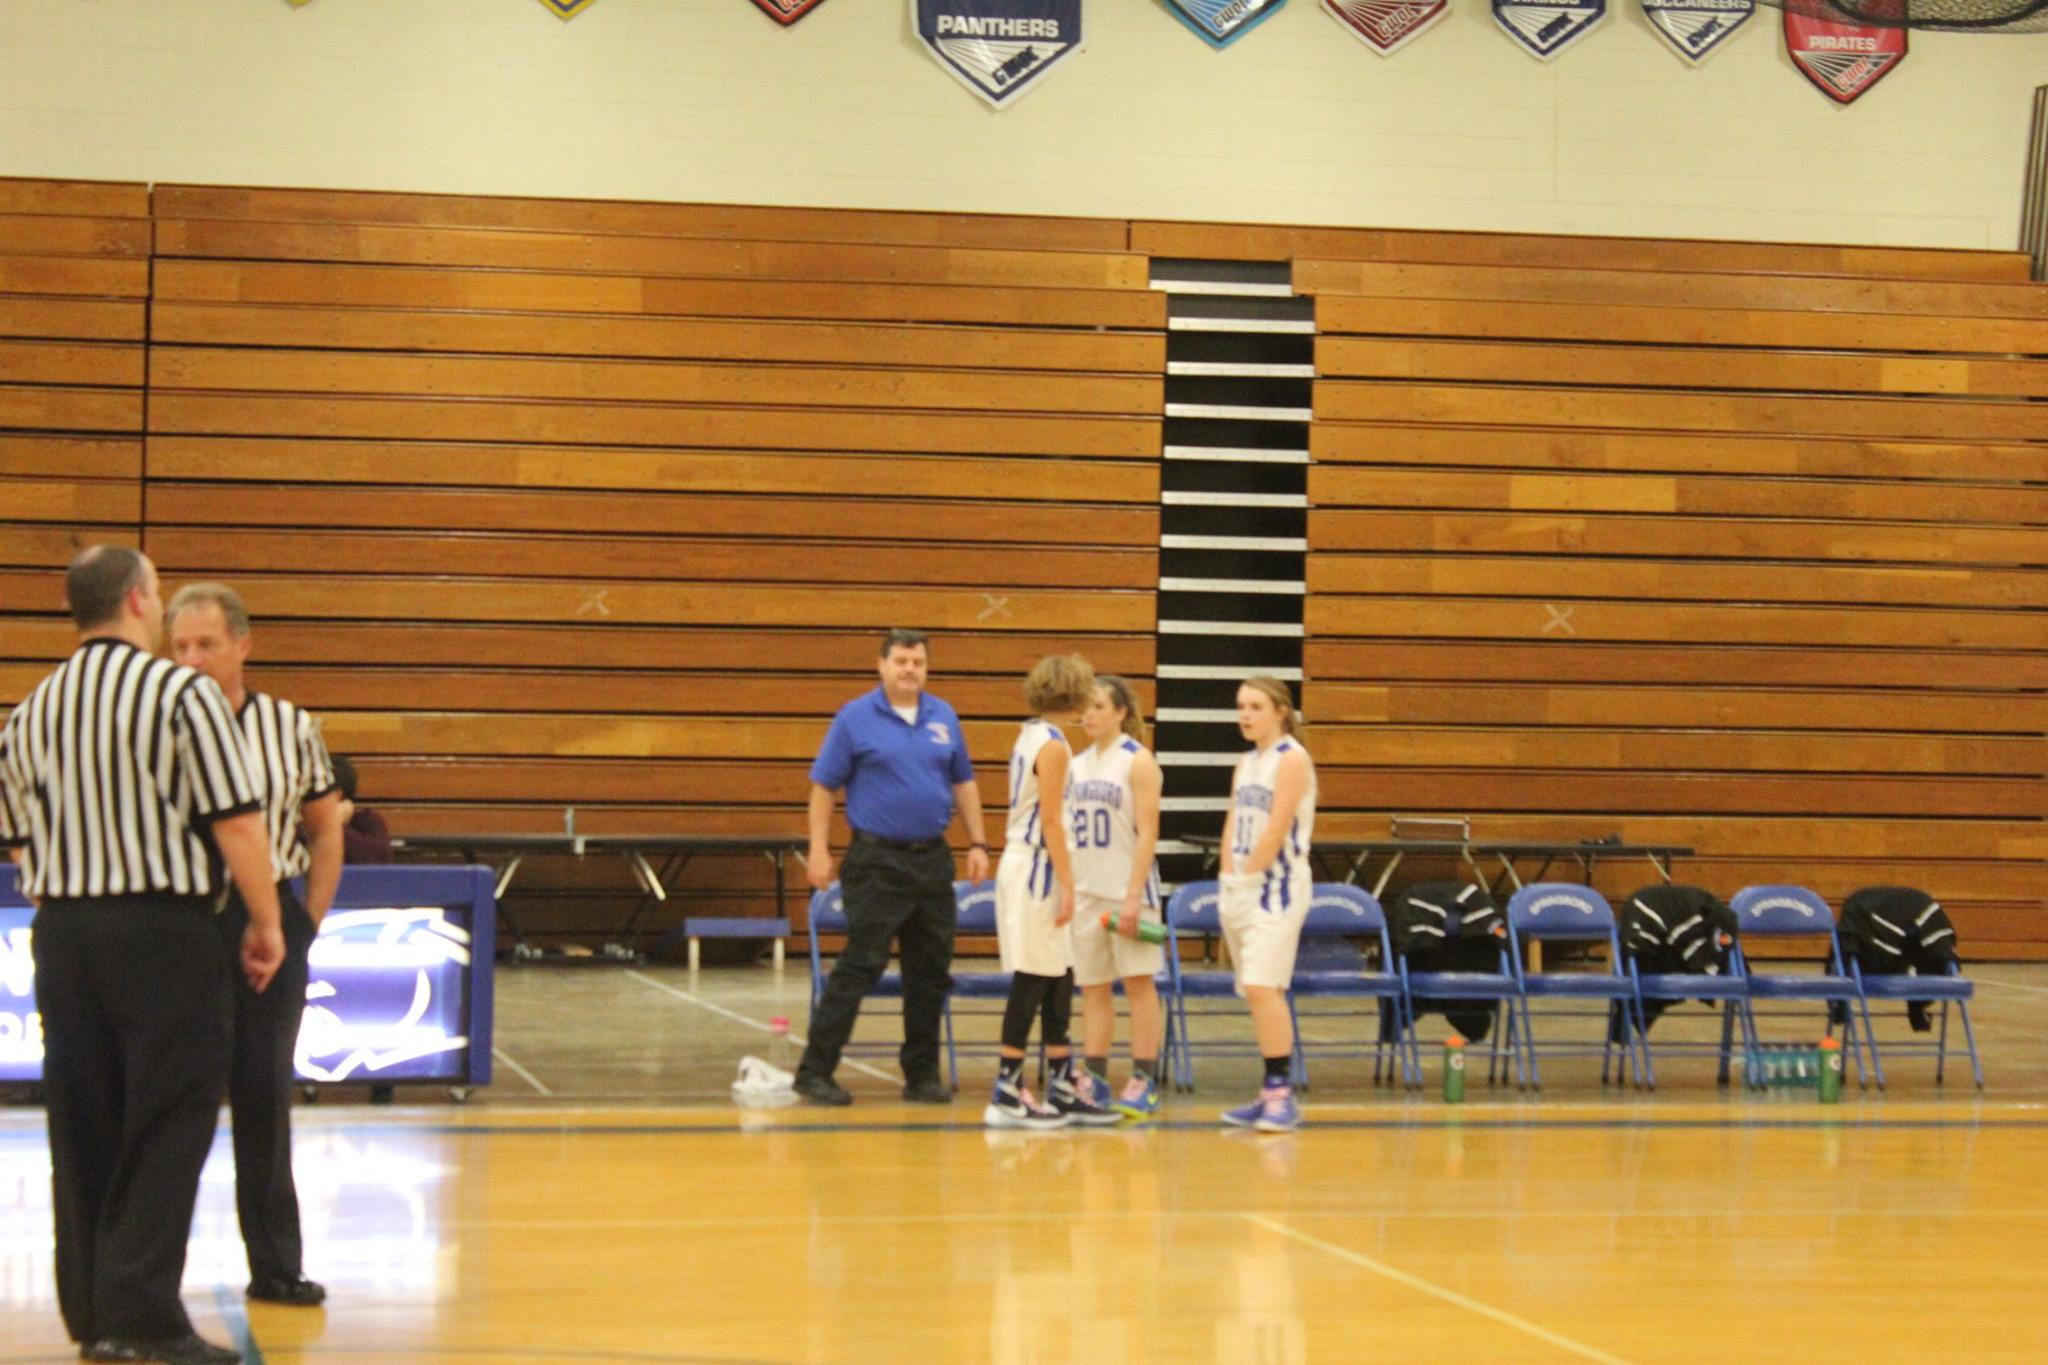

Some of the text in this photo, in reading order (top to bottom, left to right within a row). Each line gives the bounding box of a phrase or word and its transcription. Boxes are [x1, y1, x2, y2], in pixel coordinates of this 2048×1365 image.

[937, 15, 1060, 38] PANTHERS
[1808, 35, 1877, 51] PIRATES
[1073, 808, 1111, 848] 20
